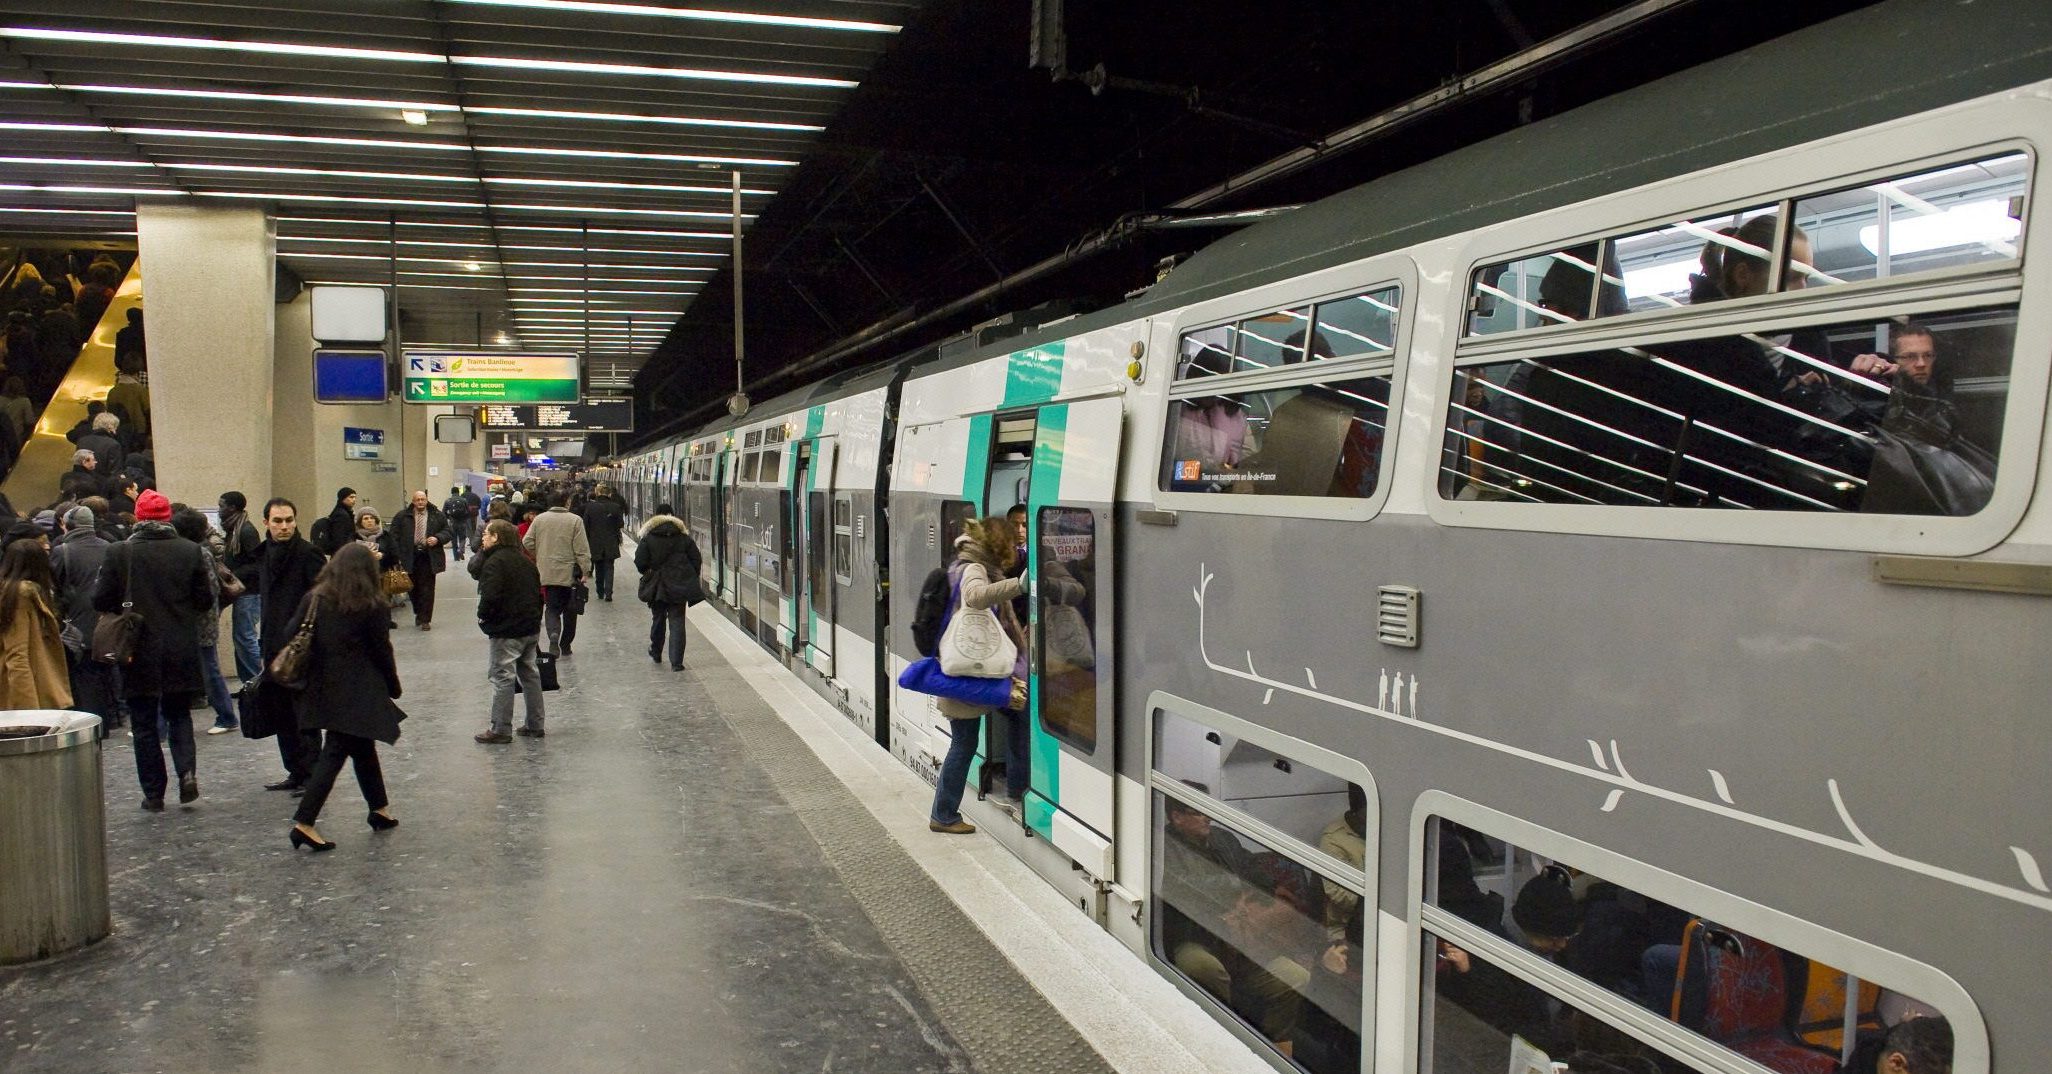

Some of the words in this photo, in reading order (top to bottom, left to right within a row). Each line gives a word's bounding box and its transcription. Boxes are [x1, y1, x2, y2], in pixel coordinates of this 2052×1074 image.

[450, 381, 469, 389] Sortie
[471, 381, 479, 389] de
[360, 431, 374, 442] Sortie
